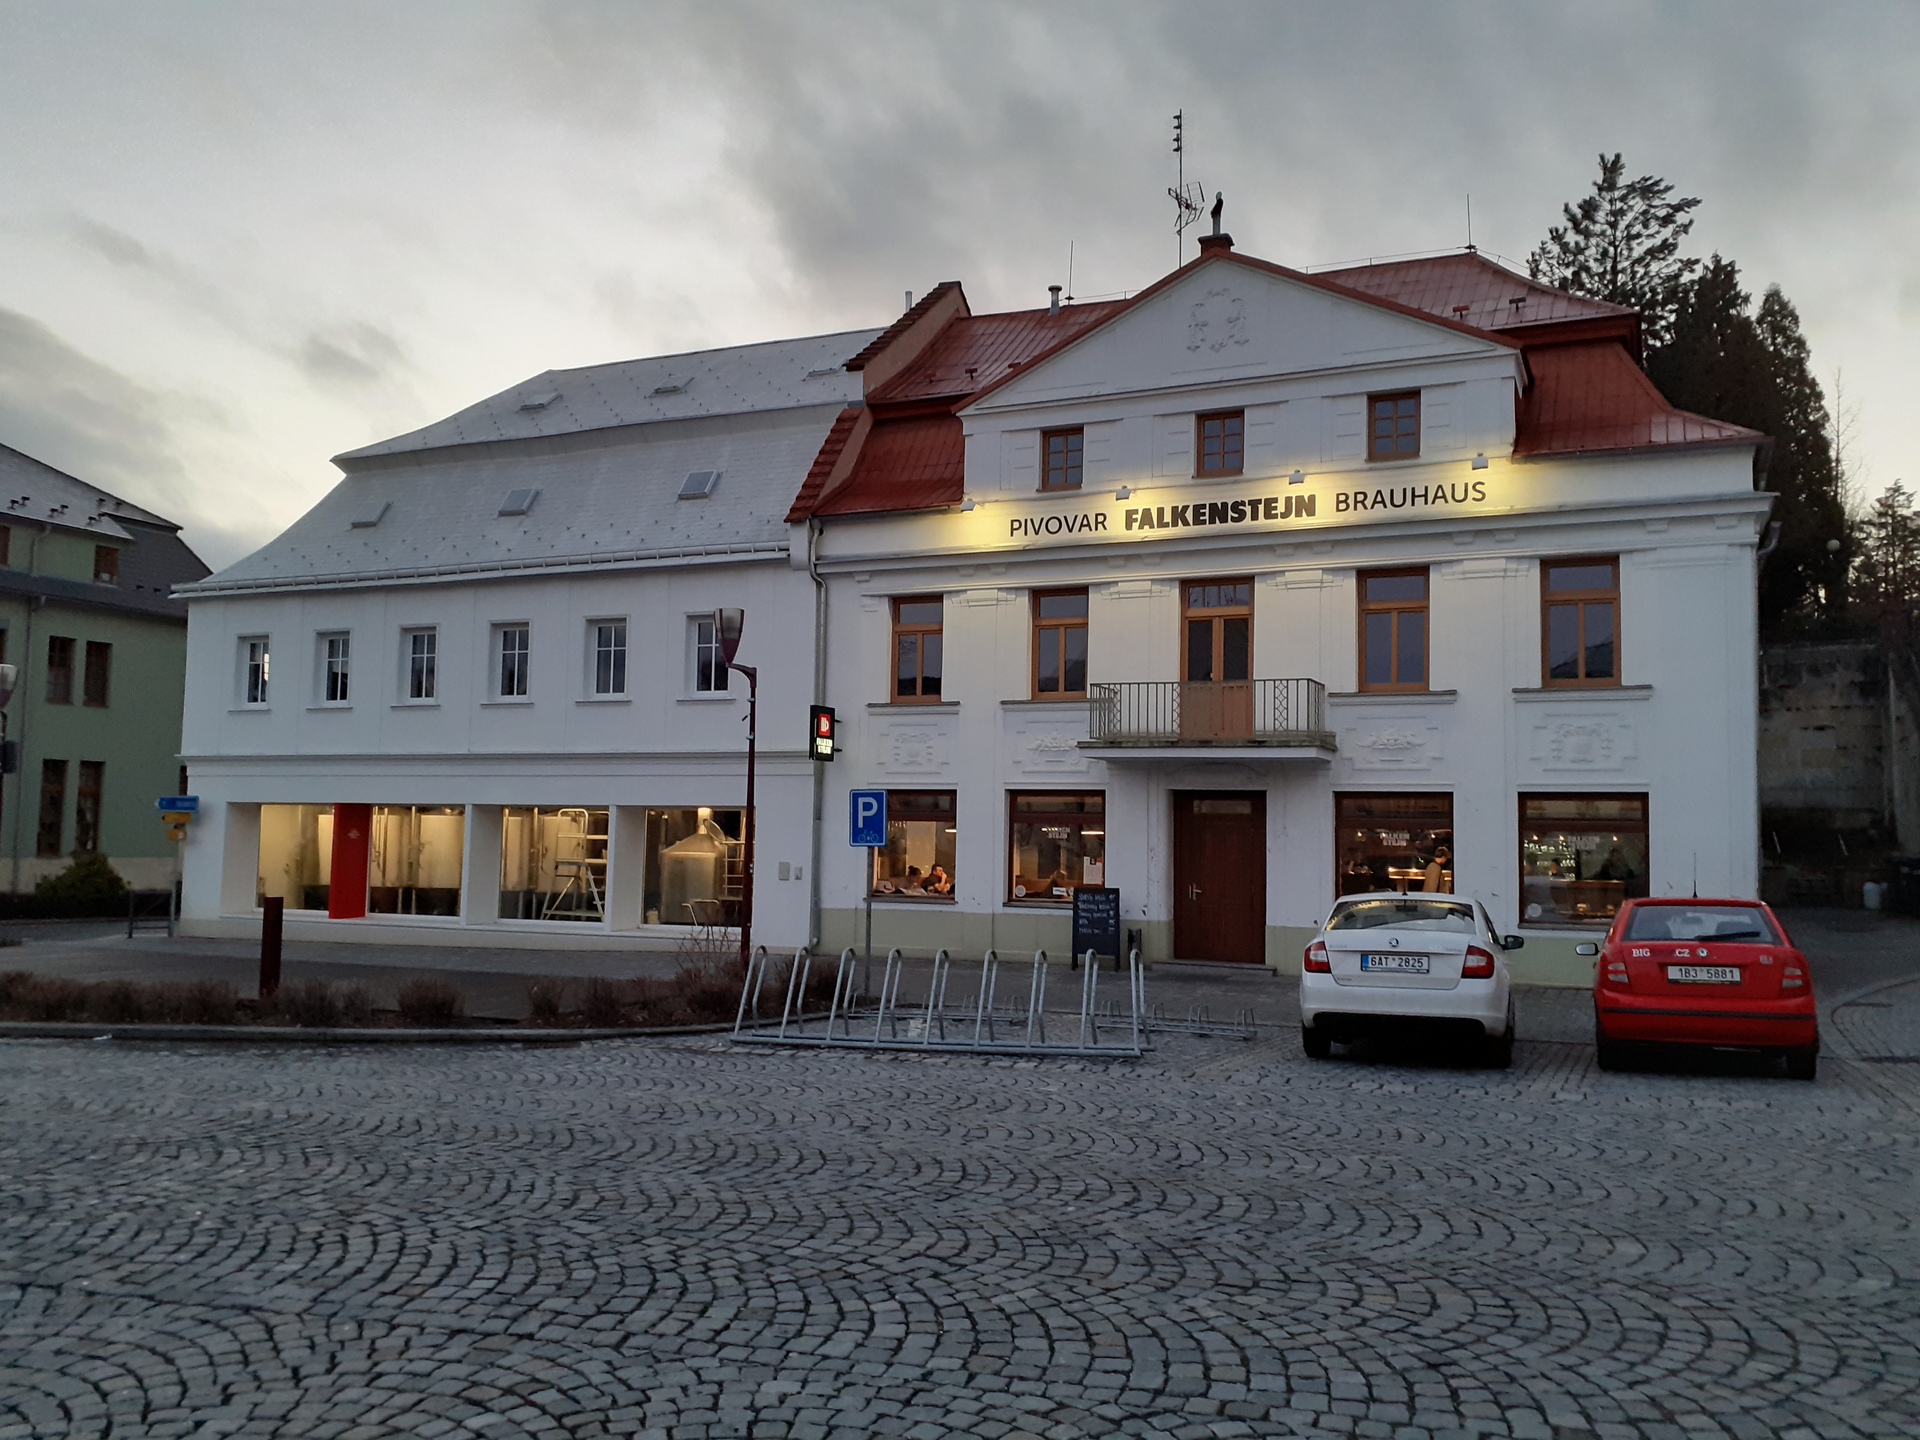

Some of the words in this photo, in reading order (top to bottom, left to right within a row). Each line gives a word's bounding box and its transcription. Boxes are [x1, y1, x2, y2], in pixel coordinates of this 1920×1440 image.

[1010, 513, 1108, 537] PIVOVAR
[1125, 494, 1316, 530] FALKENSTEJN
[1335, 481, 1487, 512] BRAUHAUS
[857, 796, 878, 828] P
[1631, 948, 1651, 958] BIG
[1370, 956, 1390, 967] 6AT
[1397, 957, 1424, 968] 2825
[1678, 967, 1698, 979] 1B3
